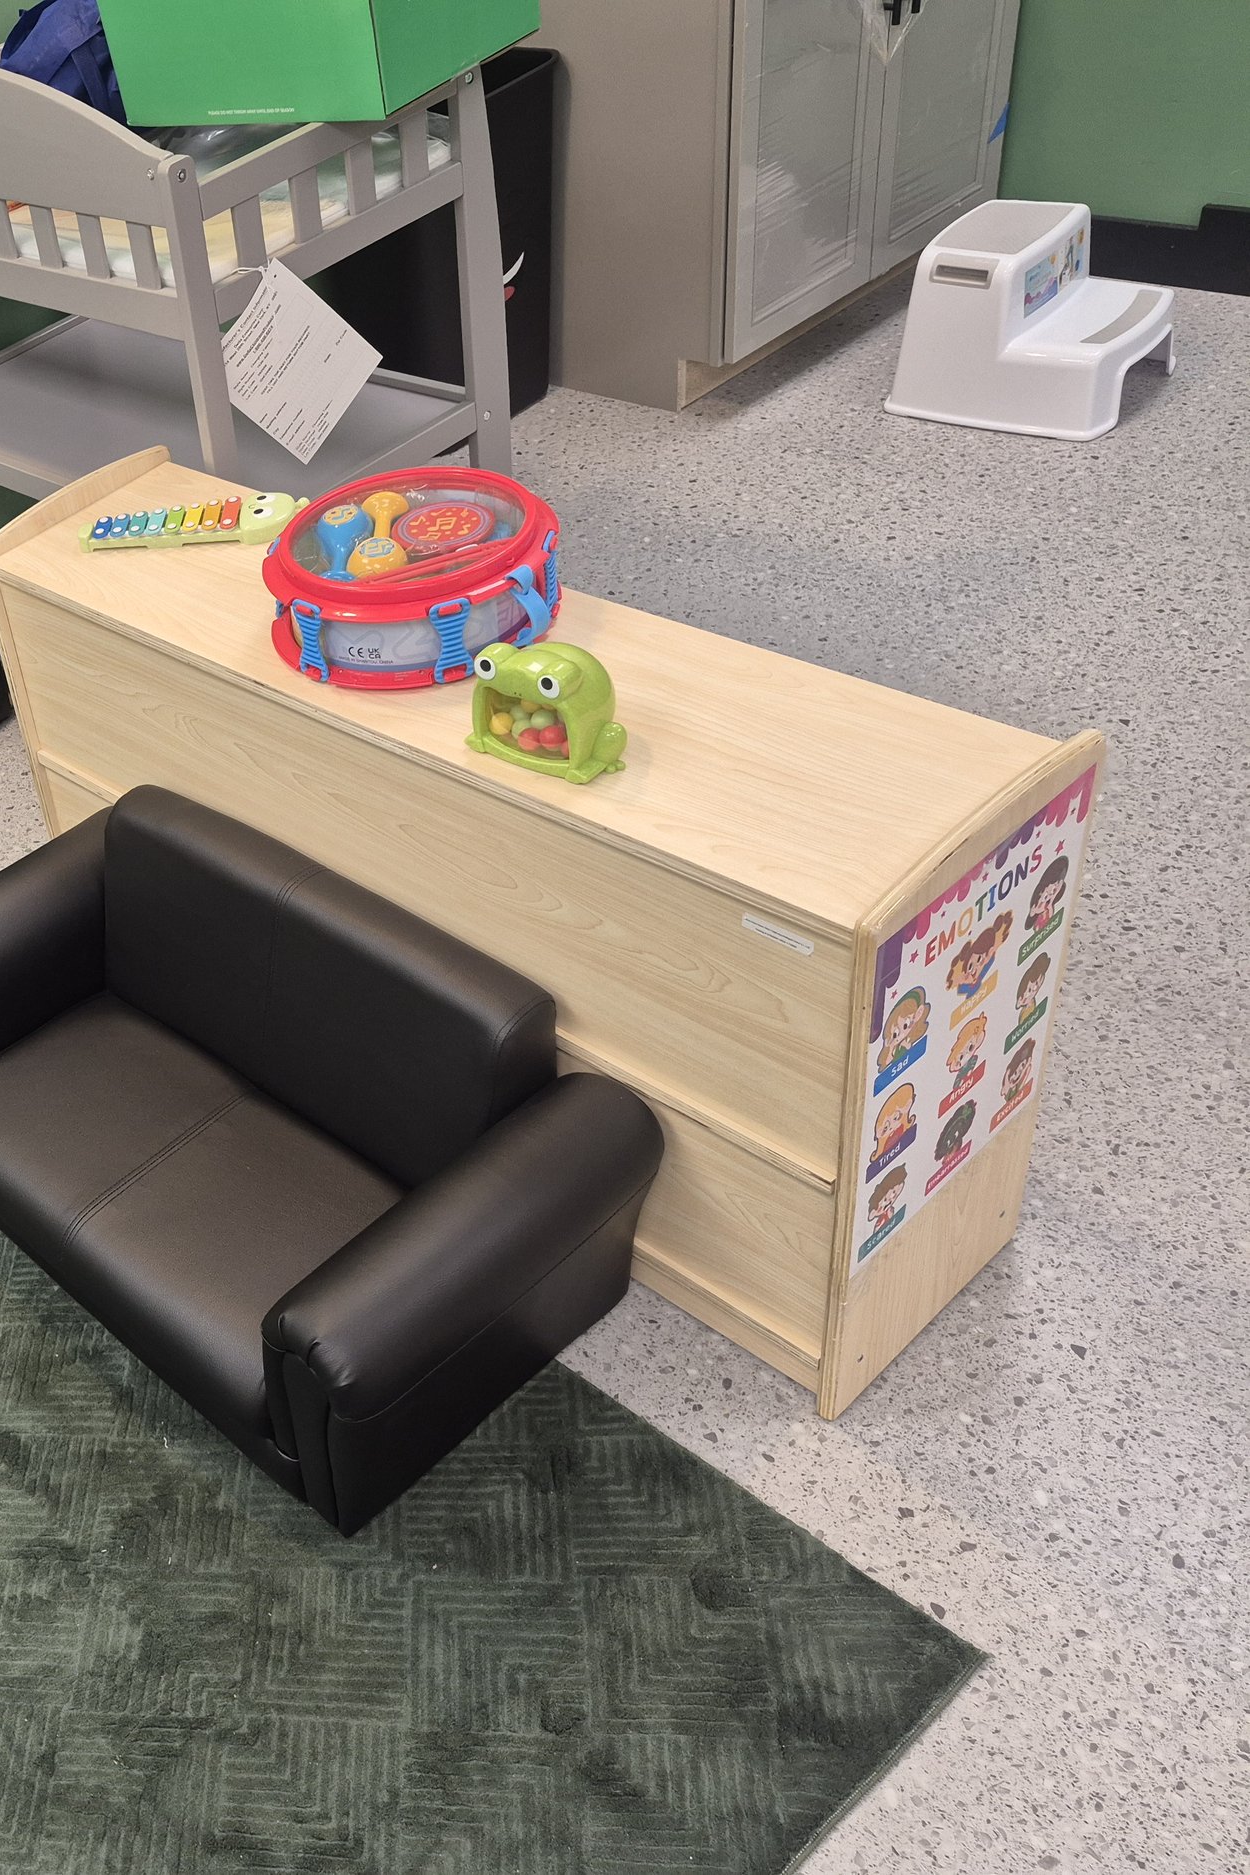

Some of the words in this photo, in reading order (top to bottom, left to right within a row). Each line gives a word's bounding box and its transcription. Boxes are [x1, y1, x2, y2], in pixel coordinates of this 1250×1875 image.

[925, 844, 1043, 967] EMOTIONS
[1021, 916, 1059, 958] Surprised
[1010, 1008, 1040, 1043] Worried
[949, 1076, 974, 1104] Angry
[996, 1090, 1025, 1122] Excited
[878, 1143, 901, 1167] Tired
